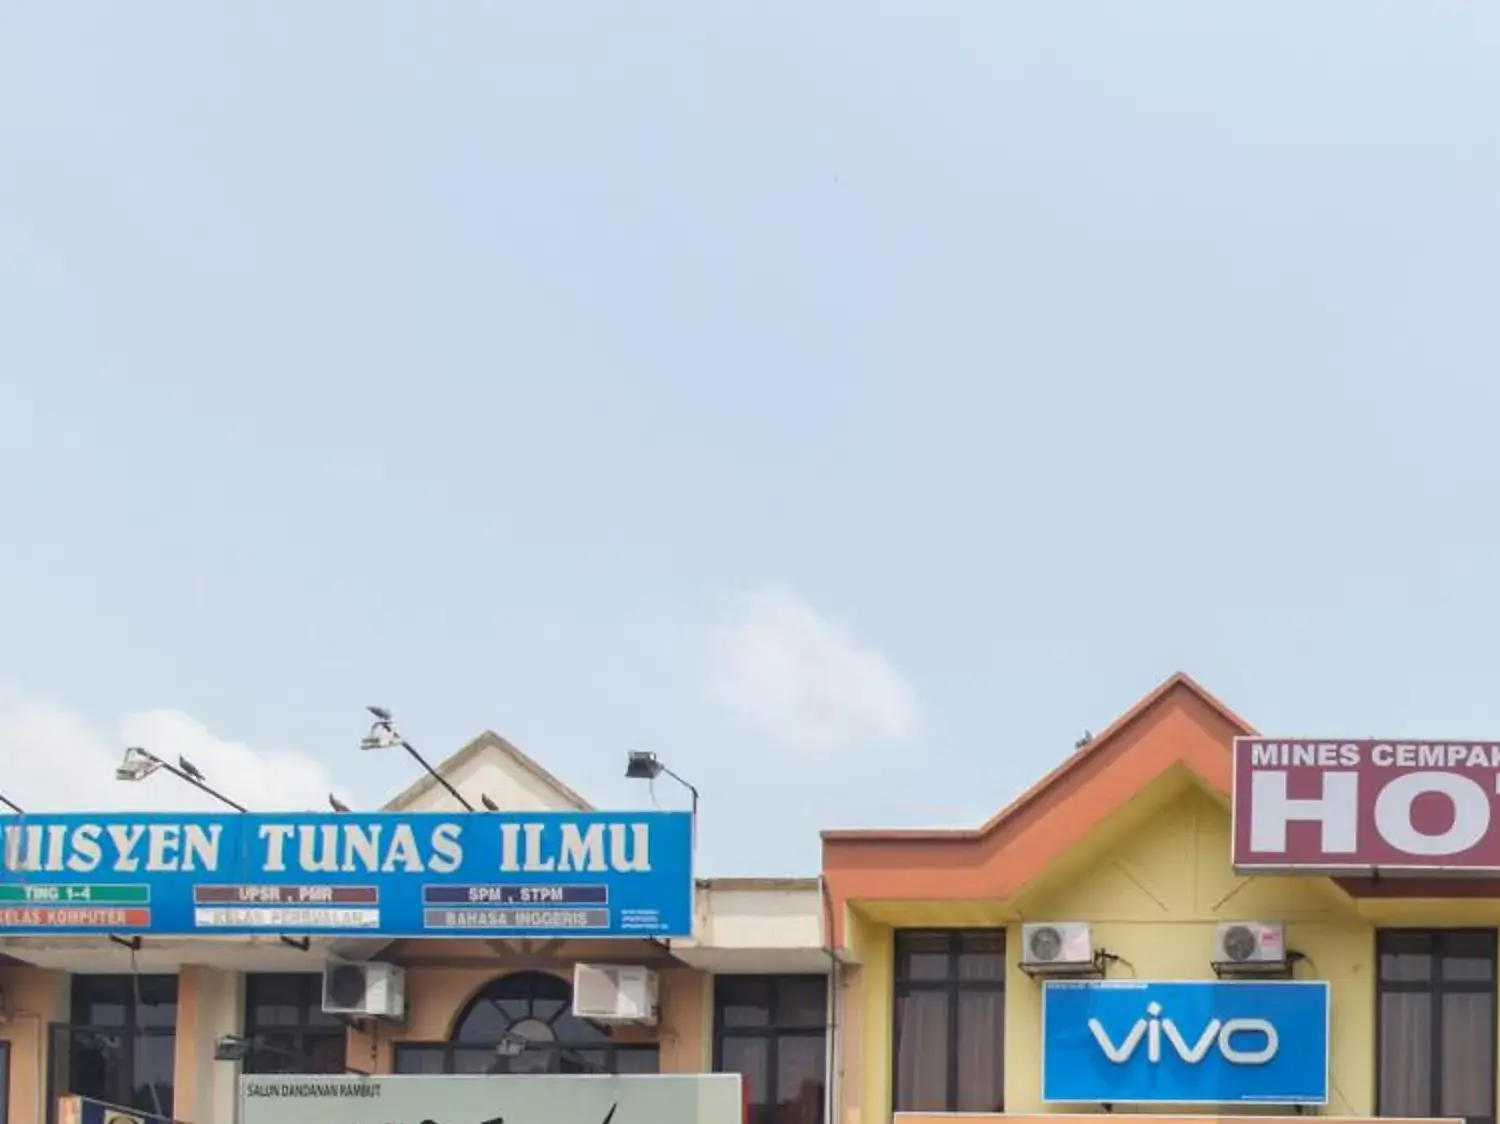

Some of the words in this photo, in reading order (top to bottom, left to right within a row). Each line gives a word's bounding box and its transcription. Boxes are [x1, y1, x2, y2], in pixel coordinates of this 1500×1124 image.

[1250, 743, 1359, 767] MINES
[0, 823, 223, 873] UISYEN
[259, 822, 463, 873] TUNAS
[499, 822, 651, 872] ILMU
[468, 887, 500, 901] SPM
[520, 887, 563, 901] STPM
[446, 911, 507, 926] BAHASA
[515, 911, 588, 927] INGGERIS
[1087, 1001, 1279, 1064] vivo
